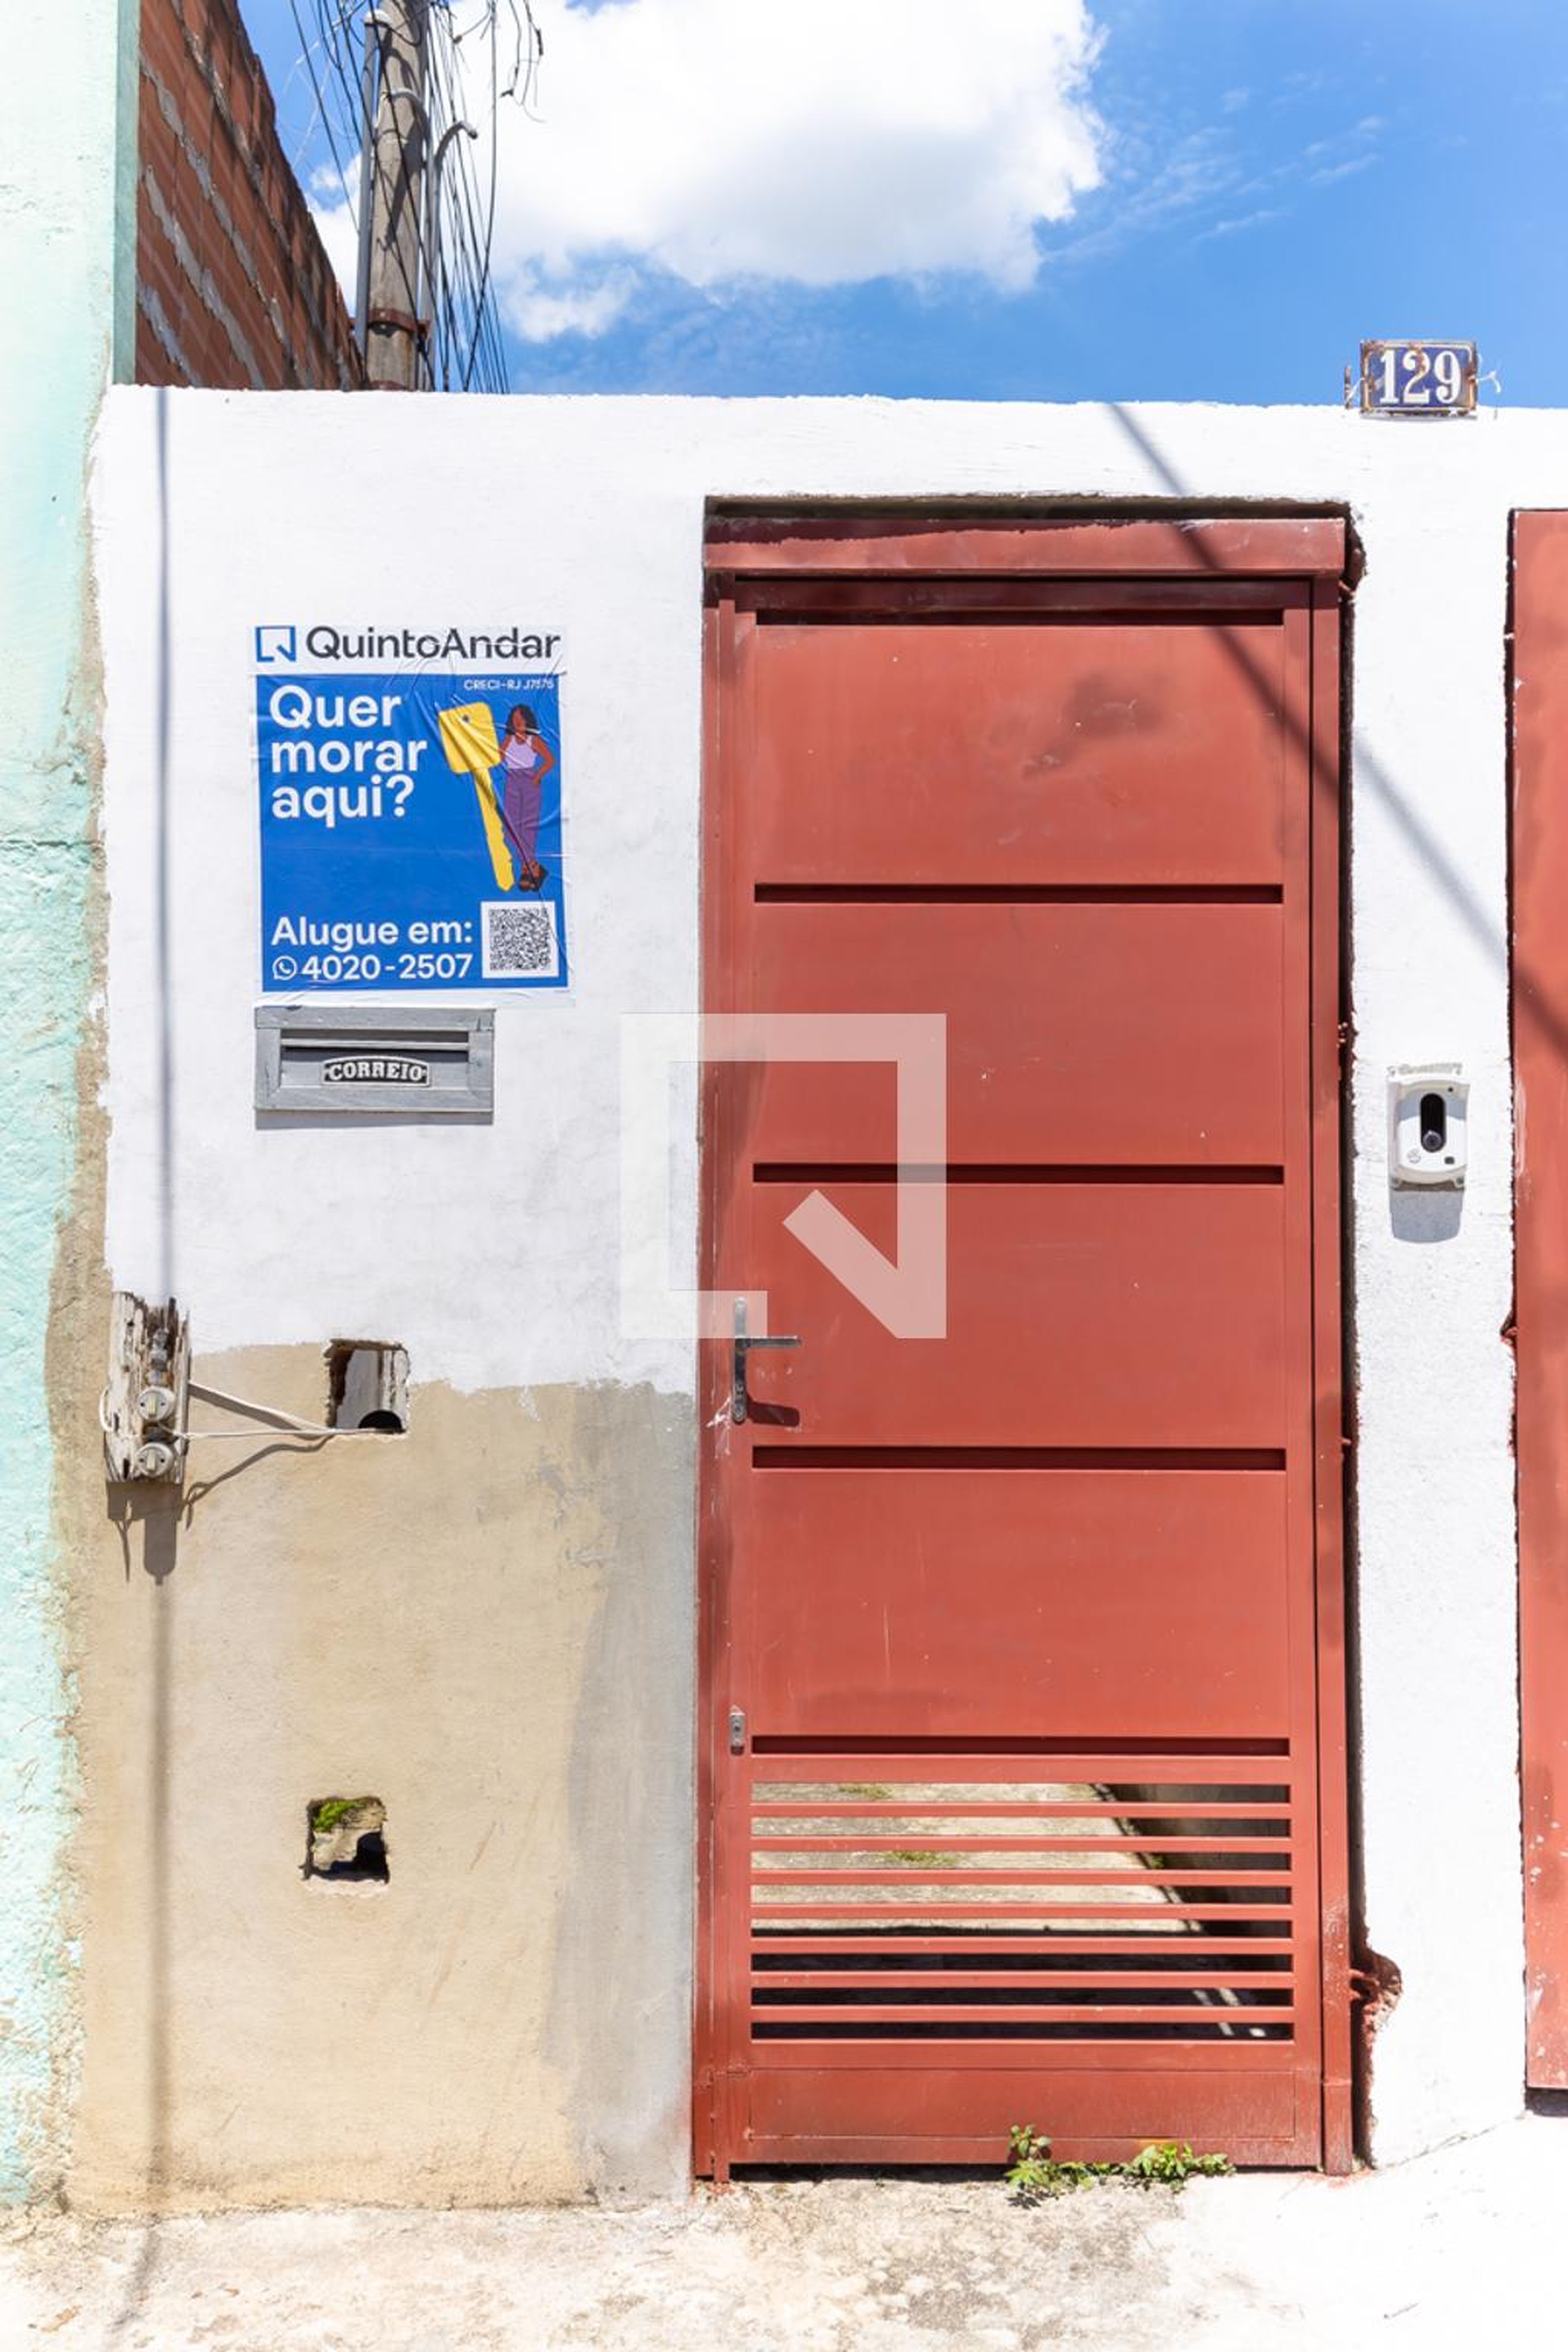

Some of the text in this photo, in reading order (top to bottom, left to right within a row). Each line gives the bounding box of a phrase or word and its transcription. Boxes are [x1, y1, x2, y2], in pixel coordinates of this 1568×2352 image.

[1379, 349, 1461, 404] 129
[306, 626, 560, 660] QuintoAndar
[270, 685, 402, 728] Quer
[272, 738, 427, 773] morar
[272, 775, 414, 828] aqui?
[271, 916, 473, 953] Alugue em:
[329, 1062, 423, 1081] CORREIO
